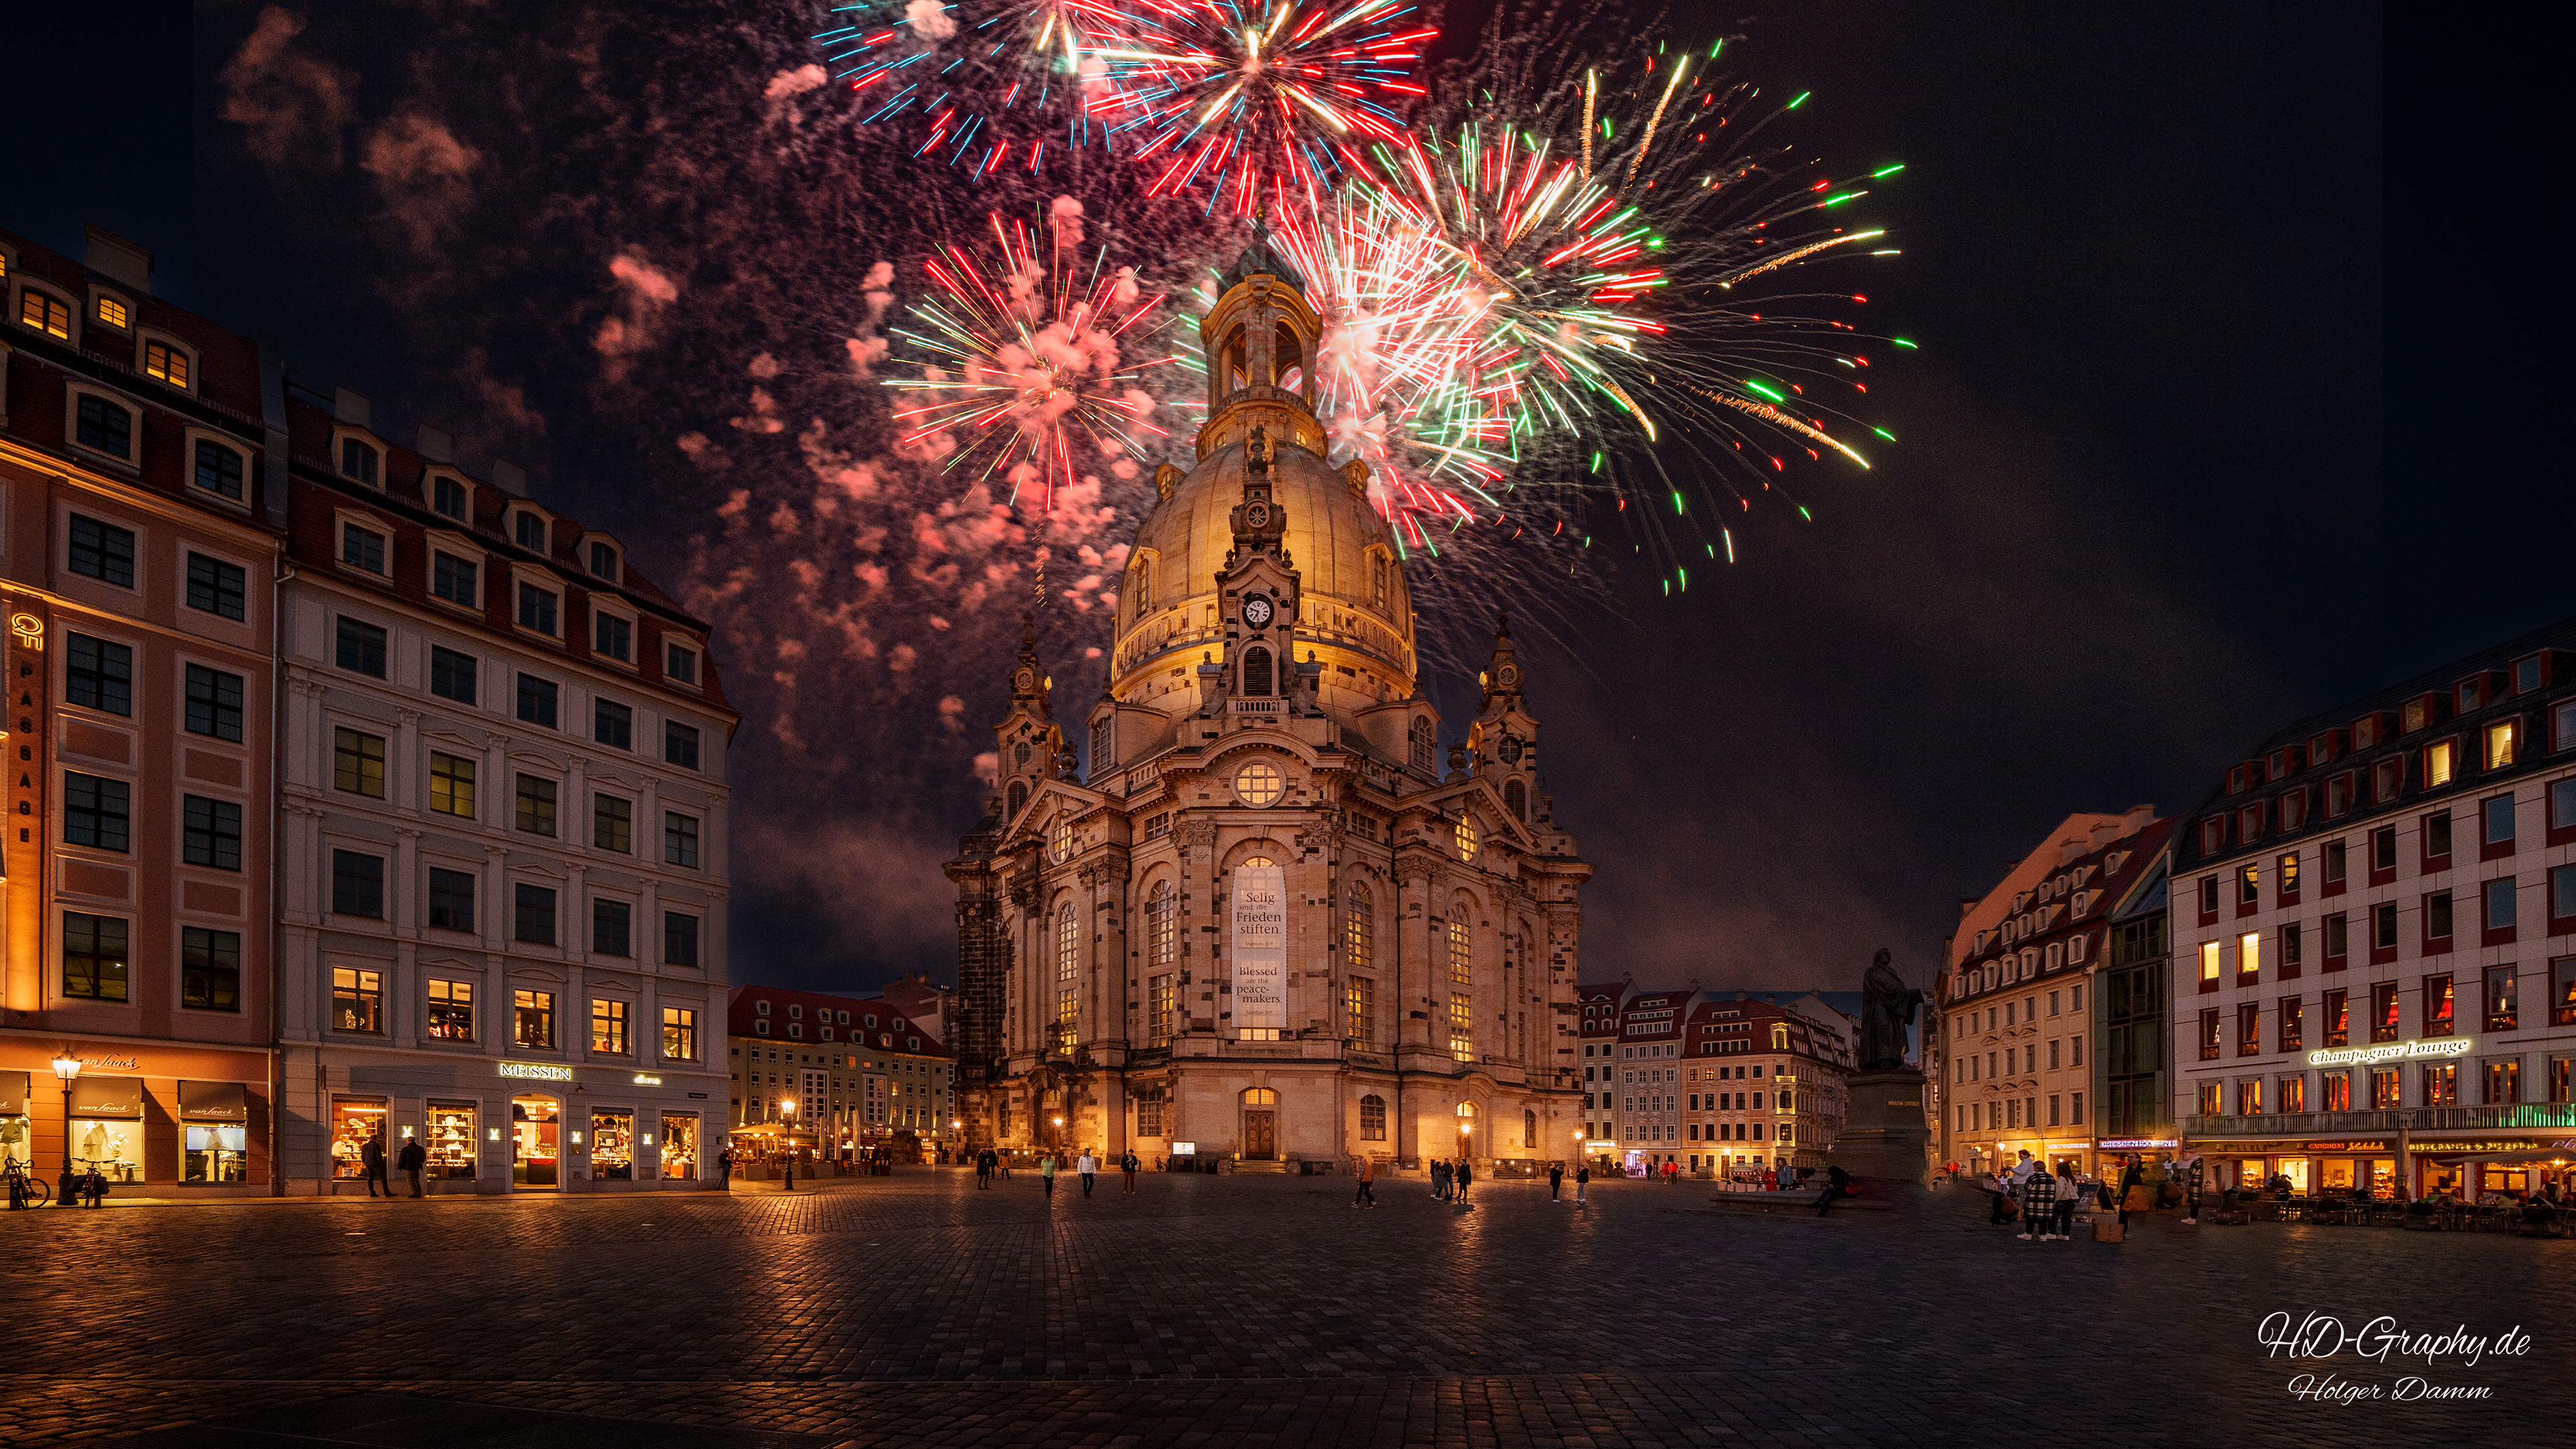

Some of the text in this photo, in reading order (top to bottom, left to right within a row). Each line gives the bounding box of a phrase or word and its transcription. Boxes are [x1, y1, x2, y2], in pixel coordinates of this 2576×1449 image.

[13, 613, 42, 650] QF
[19, 660, 33, 843] PASSAGE
[1246, 892, 1275, 906] Selig
[1236, 912, 1281, 922] Frieden
[1240, 924, 1281, 934] stiften.
[1240, 967, 1277, 975] Blessed
[1236, 986, 1270, 996] peace-
[1242, 994, 1282, 1003] makers.
[2310, 1040, 2467, 1063] Champagner Lounge
[93, 1053, 140, 1070] Laack
[501, 1064, 571, 1079] MEISSEN
[93, 1102, 130, 1113] Laack
[203, 1106, 235, 1116] Laack
